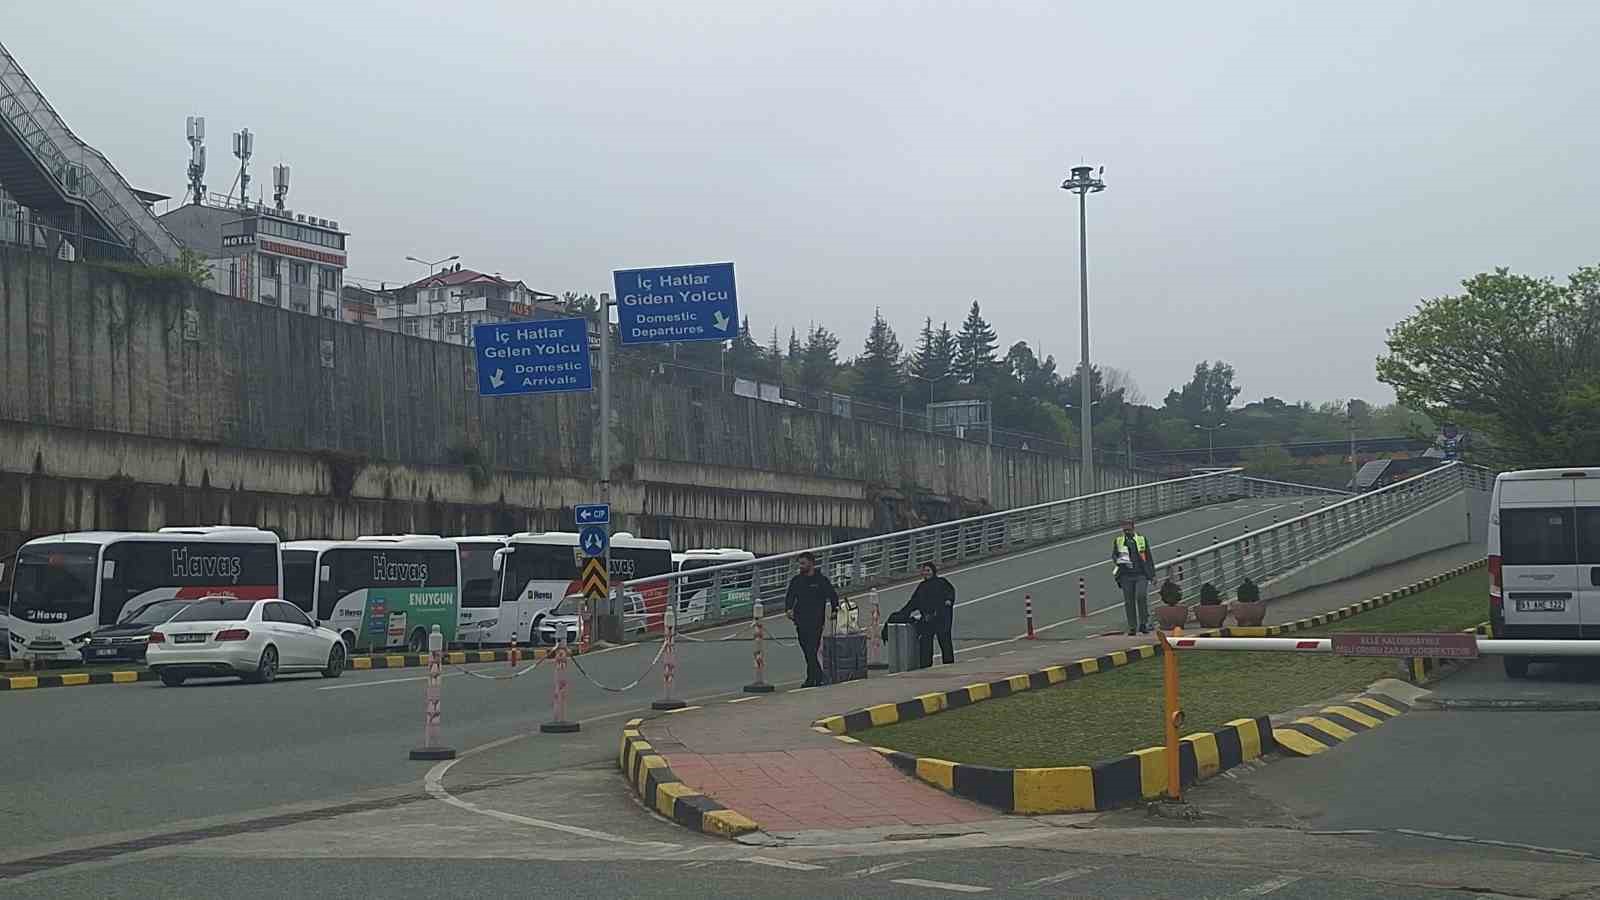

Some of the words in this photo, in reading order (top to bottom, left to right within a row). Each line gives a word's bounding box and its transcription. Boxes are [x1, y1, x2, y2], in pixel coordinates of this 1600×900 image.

[223, 236, 253, 247] HOTEL
[637, 272, 652, 290] İç
[659, 272, 712, 288] Hatlar
[623, 291, 674, 307] Giden
[679, 289, 728, 304] Yolcu
[636, 311, 697, 324] Domestic
[495, 327, 510, 344] İç
[516, 326, 565, 342] Hatlar
[632, 324, 704, 339] Departures
[484, 344, 534, 360] Gelen
[535, 342, 581, 356] Yolcu
[514, 360, 582, 375] Domestic
[521, 374, 577, 387] Arrivals
[171, 546, 241, 584] Havaş
[373, 553, 428, 588] Havaş
[409, 591, 453, 606] ENUYGUN
[36, 610, 68, 621] Havaş
